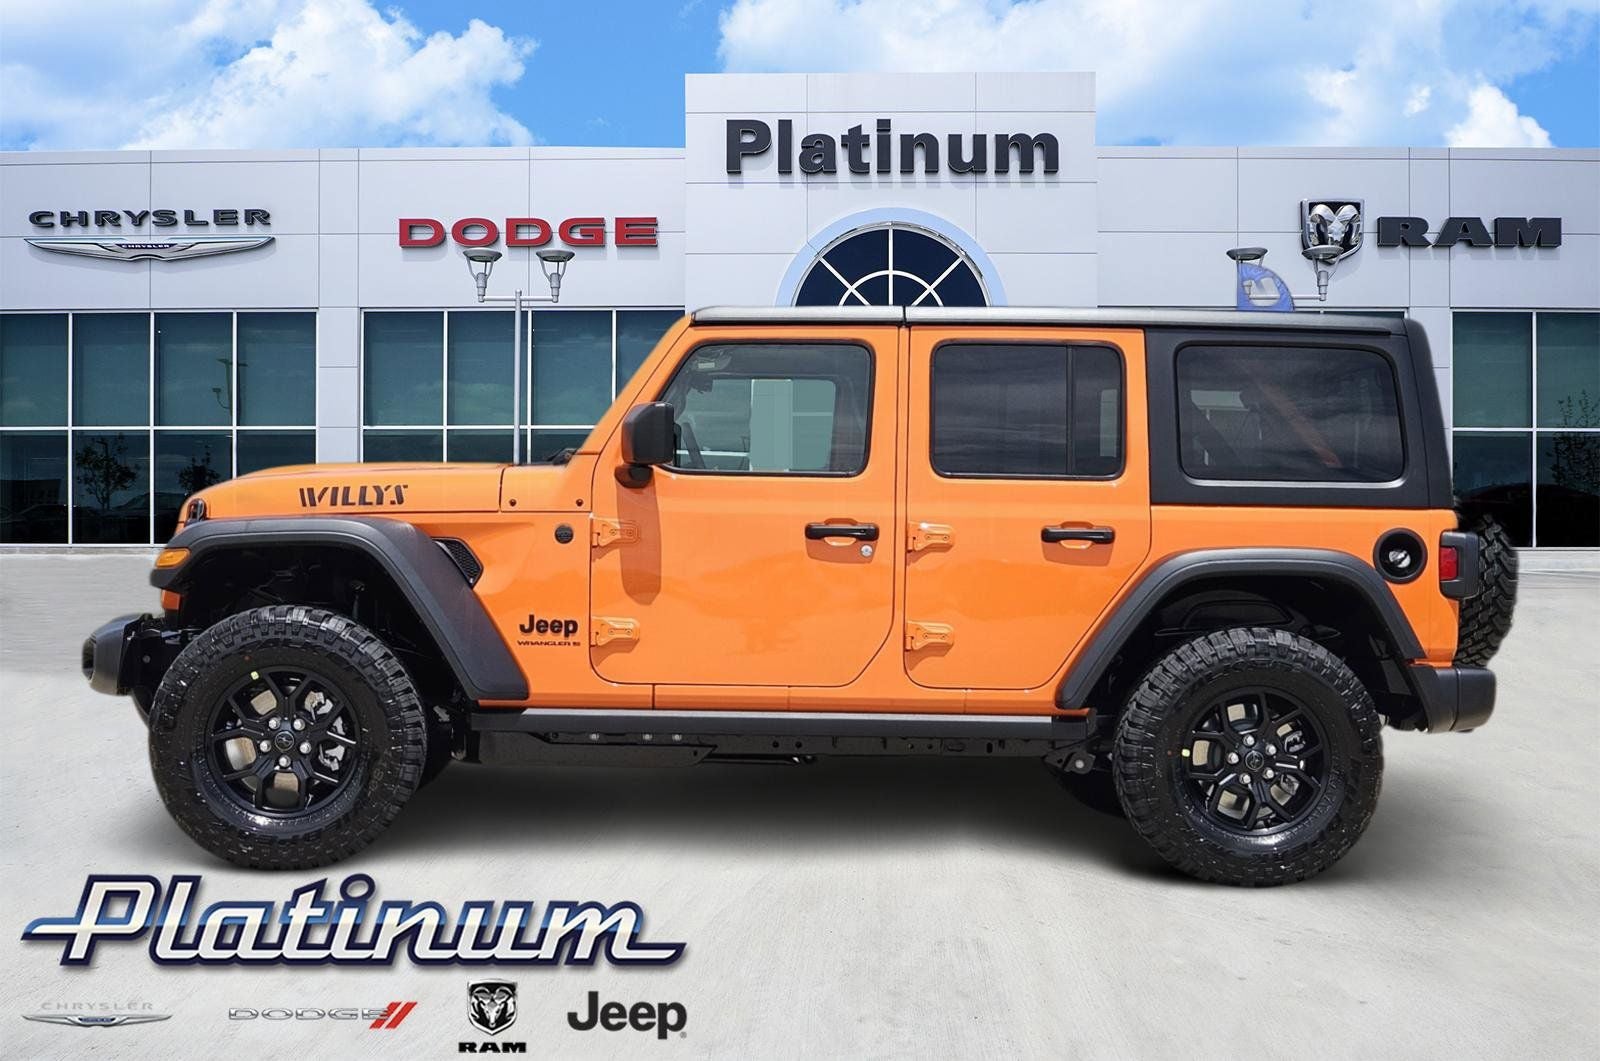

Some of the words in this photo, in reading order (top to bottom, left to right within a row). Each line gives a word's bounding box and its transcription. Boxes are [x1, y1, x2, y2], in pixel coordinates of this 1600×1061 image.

[726, 118, 1060, 176] Platinum
[28, 208, 272, 228] CHRYSLER
[1376, 216, 1562, 248] RAM
[398, 216, 659, 249] DODGE
[299, 484, 409, 508] WILLYS
[519, 613, 579, 638] Jeep
